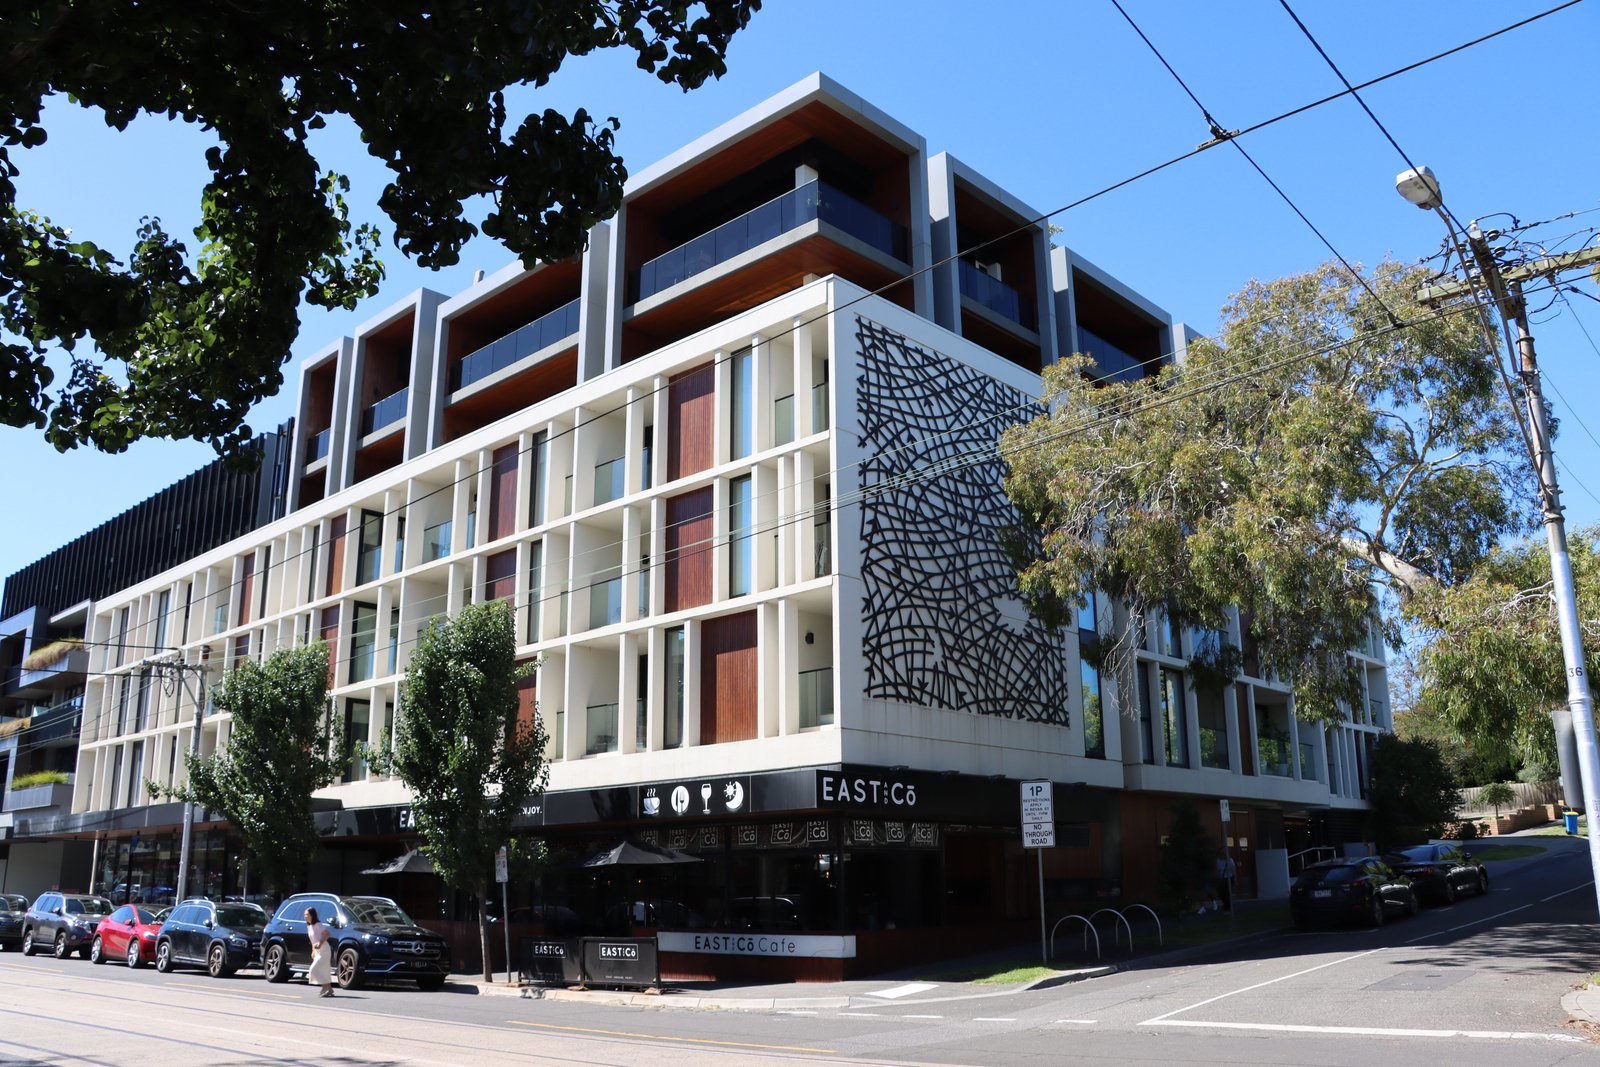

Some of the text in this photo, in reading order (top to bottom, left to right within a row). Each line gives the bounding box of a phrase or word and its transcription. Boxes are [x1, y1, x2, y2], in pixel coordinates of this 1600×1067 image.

[1568, 667, 1583, 677] 36
[823, 777, 880, 803] EAST
[1030, 786, 1042, 796] 1P
[535, 945, 552, 954] EAST
[694, 936, 730, 950] EAST
[758, 937, 796, 953] Cafe
[601, 947, 621, 957] EAST
